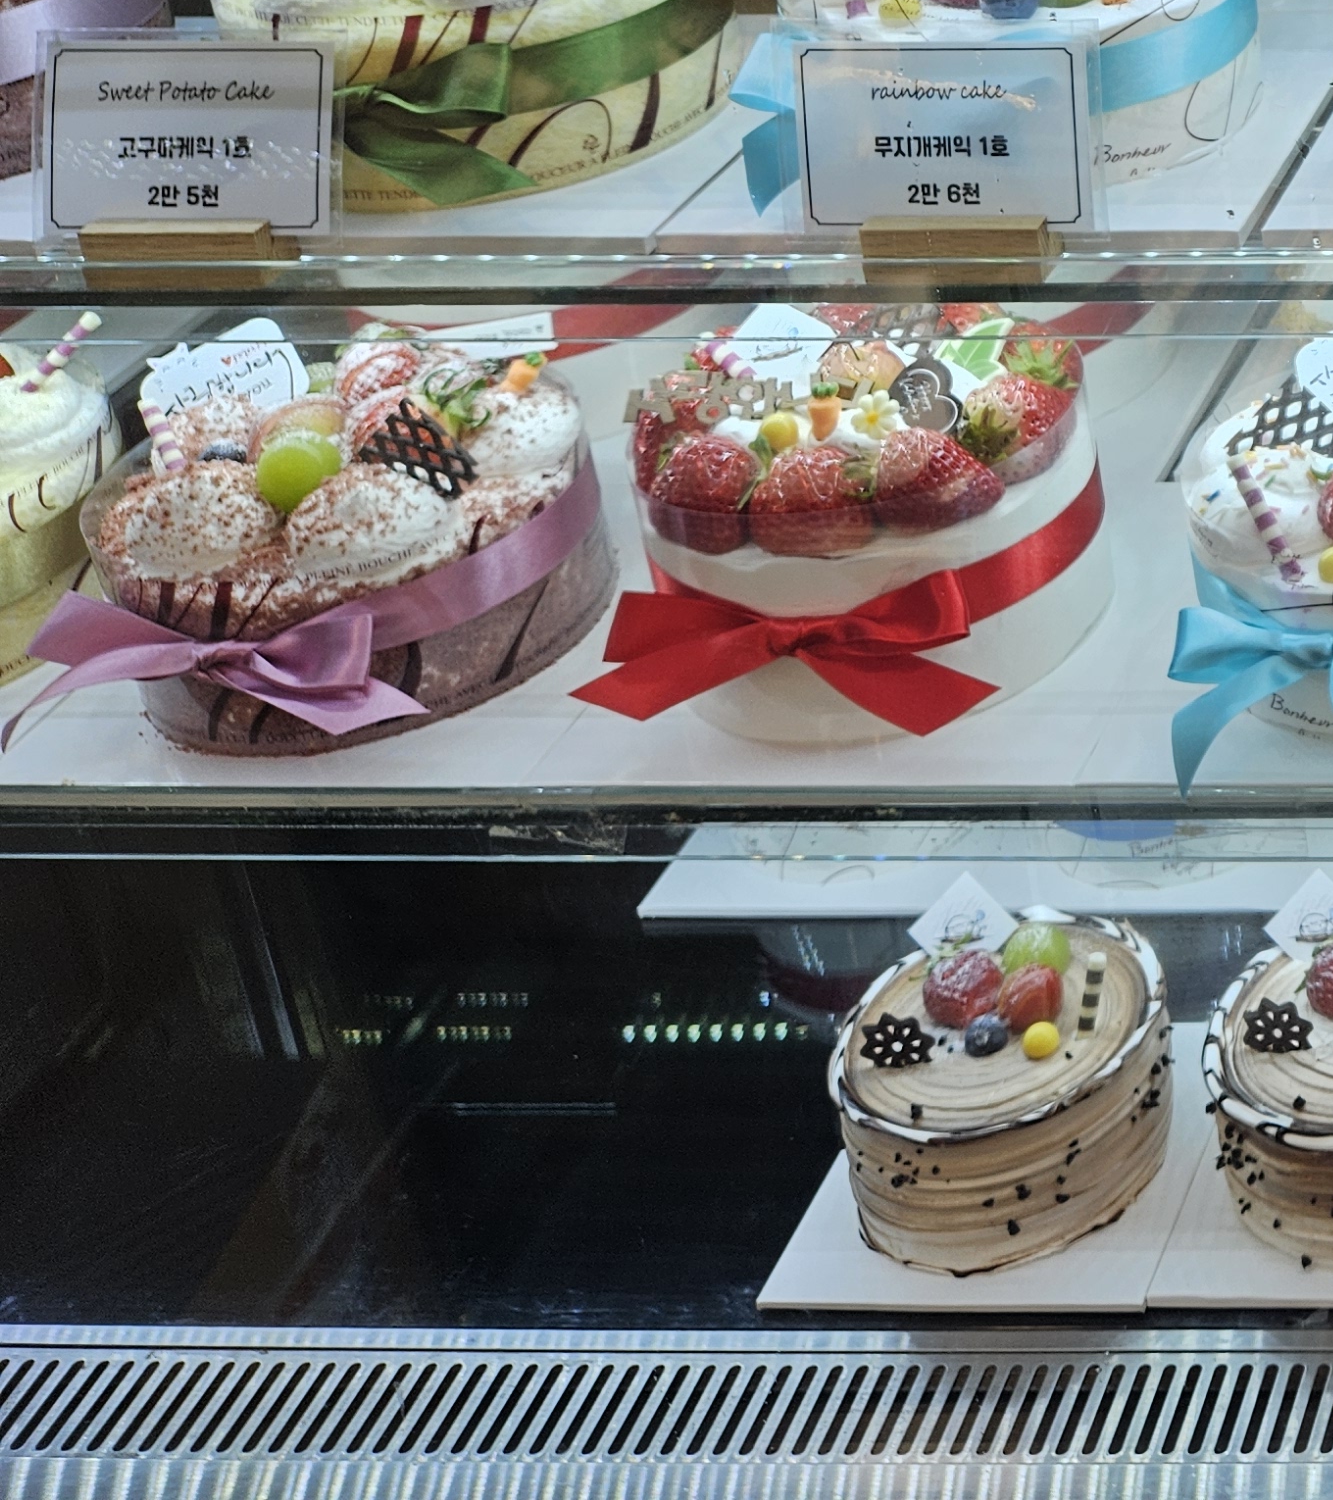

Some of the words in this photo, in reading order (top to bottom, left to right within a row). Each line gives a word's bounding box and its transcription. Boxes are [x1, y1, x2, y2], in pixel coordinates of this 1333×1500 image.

[97, 80, 155, 102] Sweet
[159, 80, 220, 102] Potato
[224, 80, 276, 102] Cake
[870, 79, 958, 102] rainbow
[960, 79, 1008, 100] cake
[118, 135, 215, 160] 고구마케익
[222, 135, 253, 159] 1호
[874, 135, 972, 159] 무지개케익
[978, 134, 1011, 158] 1호
[147, 184, 181, 208] 2만
[186, 184, 219, 208] 5천
[907, 182, 941, 206] 2만
[946, 182, 982, 206] 6천
